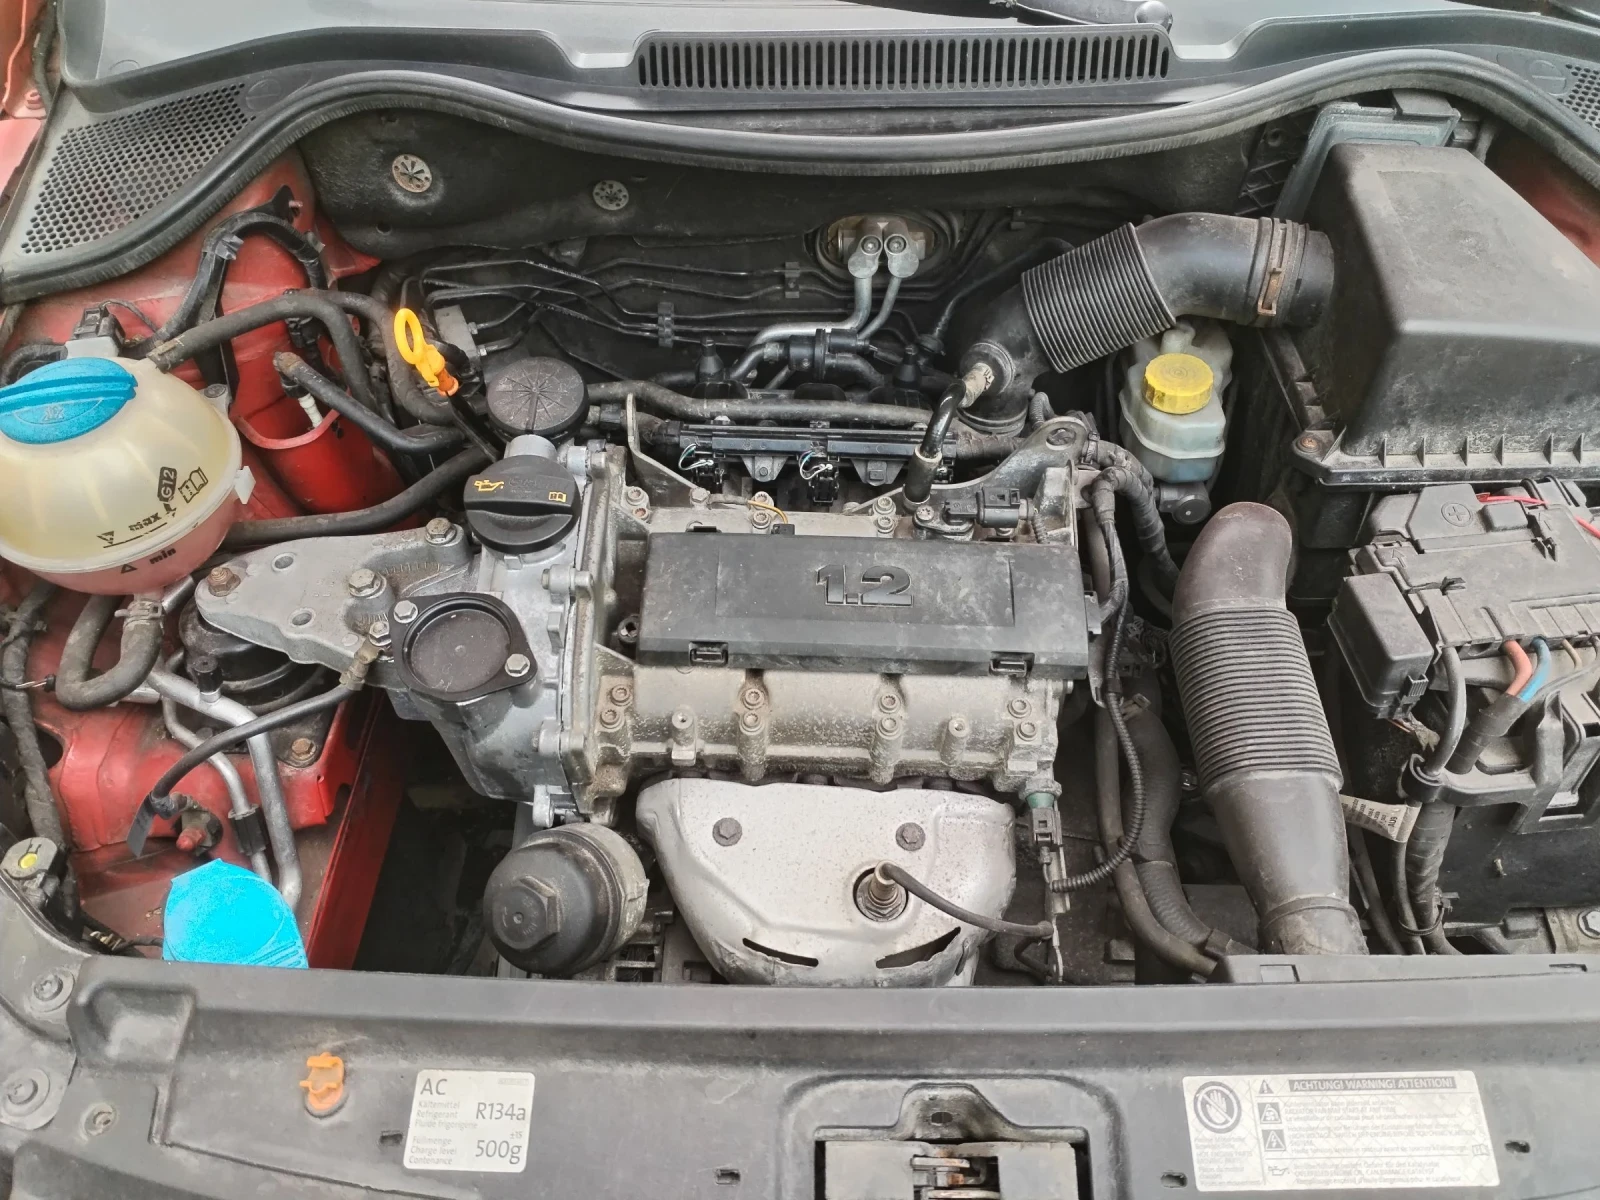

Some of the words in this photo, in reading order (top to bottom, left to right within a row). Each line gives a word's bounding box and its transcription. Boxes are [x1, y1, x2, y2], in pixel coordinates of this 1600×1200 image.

[160, 469, 175, 499] G12
[128, 512, 162, 531] max
[149, 548, 177, 564] min
[816, 564, 914, 607] 1.2
[420, 1078, 447, 1095] AC
[1293, 1080, 1344, 1091] ACHTUNG!
[1345, 1079, 1396, 1090] WARNING!
[1398, 1078, 1453, 1089] ATTENTION!
[416, 1110, 458, 1120] Refrigerant
[476, 1102, 526, 1121] R134a
[410, 1146, 437, 1156] Charge
[439, 1147, 457, 1155] level
[475, 1140, 522, 1165] 500g
[409, 1156, 453, 1165] Contenance
